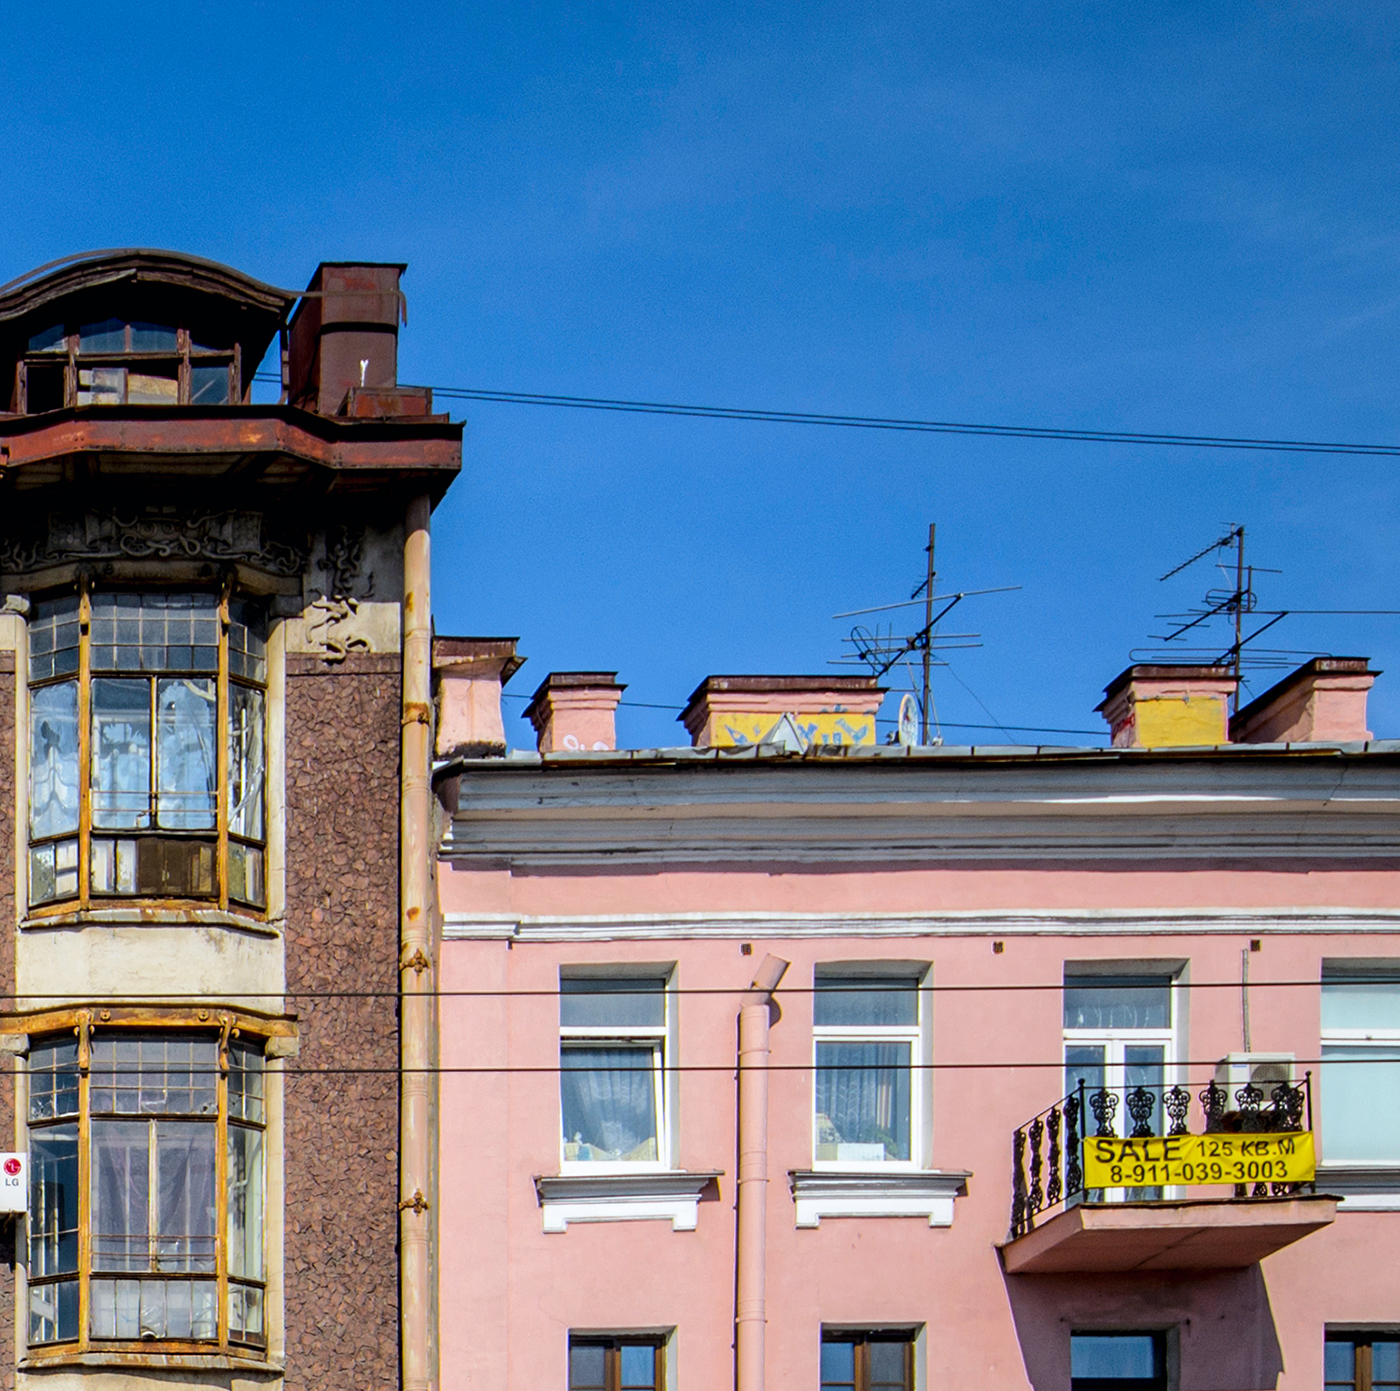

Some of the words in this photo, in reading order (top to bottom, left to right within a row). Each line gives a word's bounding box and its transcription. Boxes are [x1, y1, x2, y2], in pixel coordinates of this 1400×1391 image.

[1095, 1138, 1182, 1163] SALE
[1196, 1141, 1233, 1157] 125
[5, 1178, 19, 1186] LG
[1110, 1161, 1289, 1183] 8-911-039-3003
